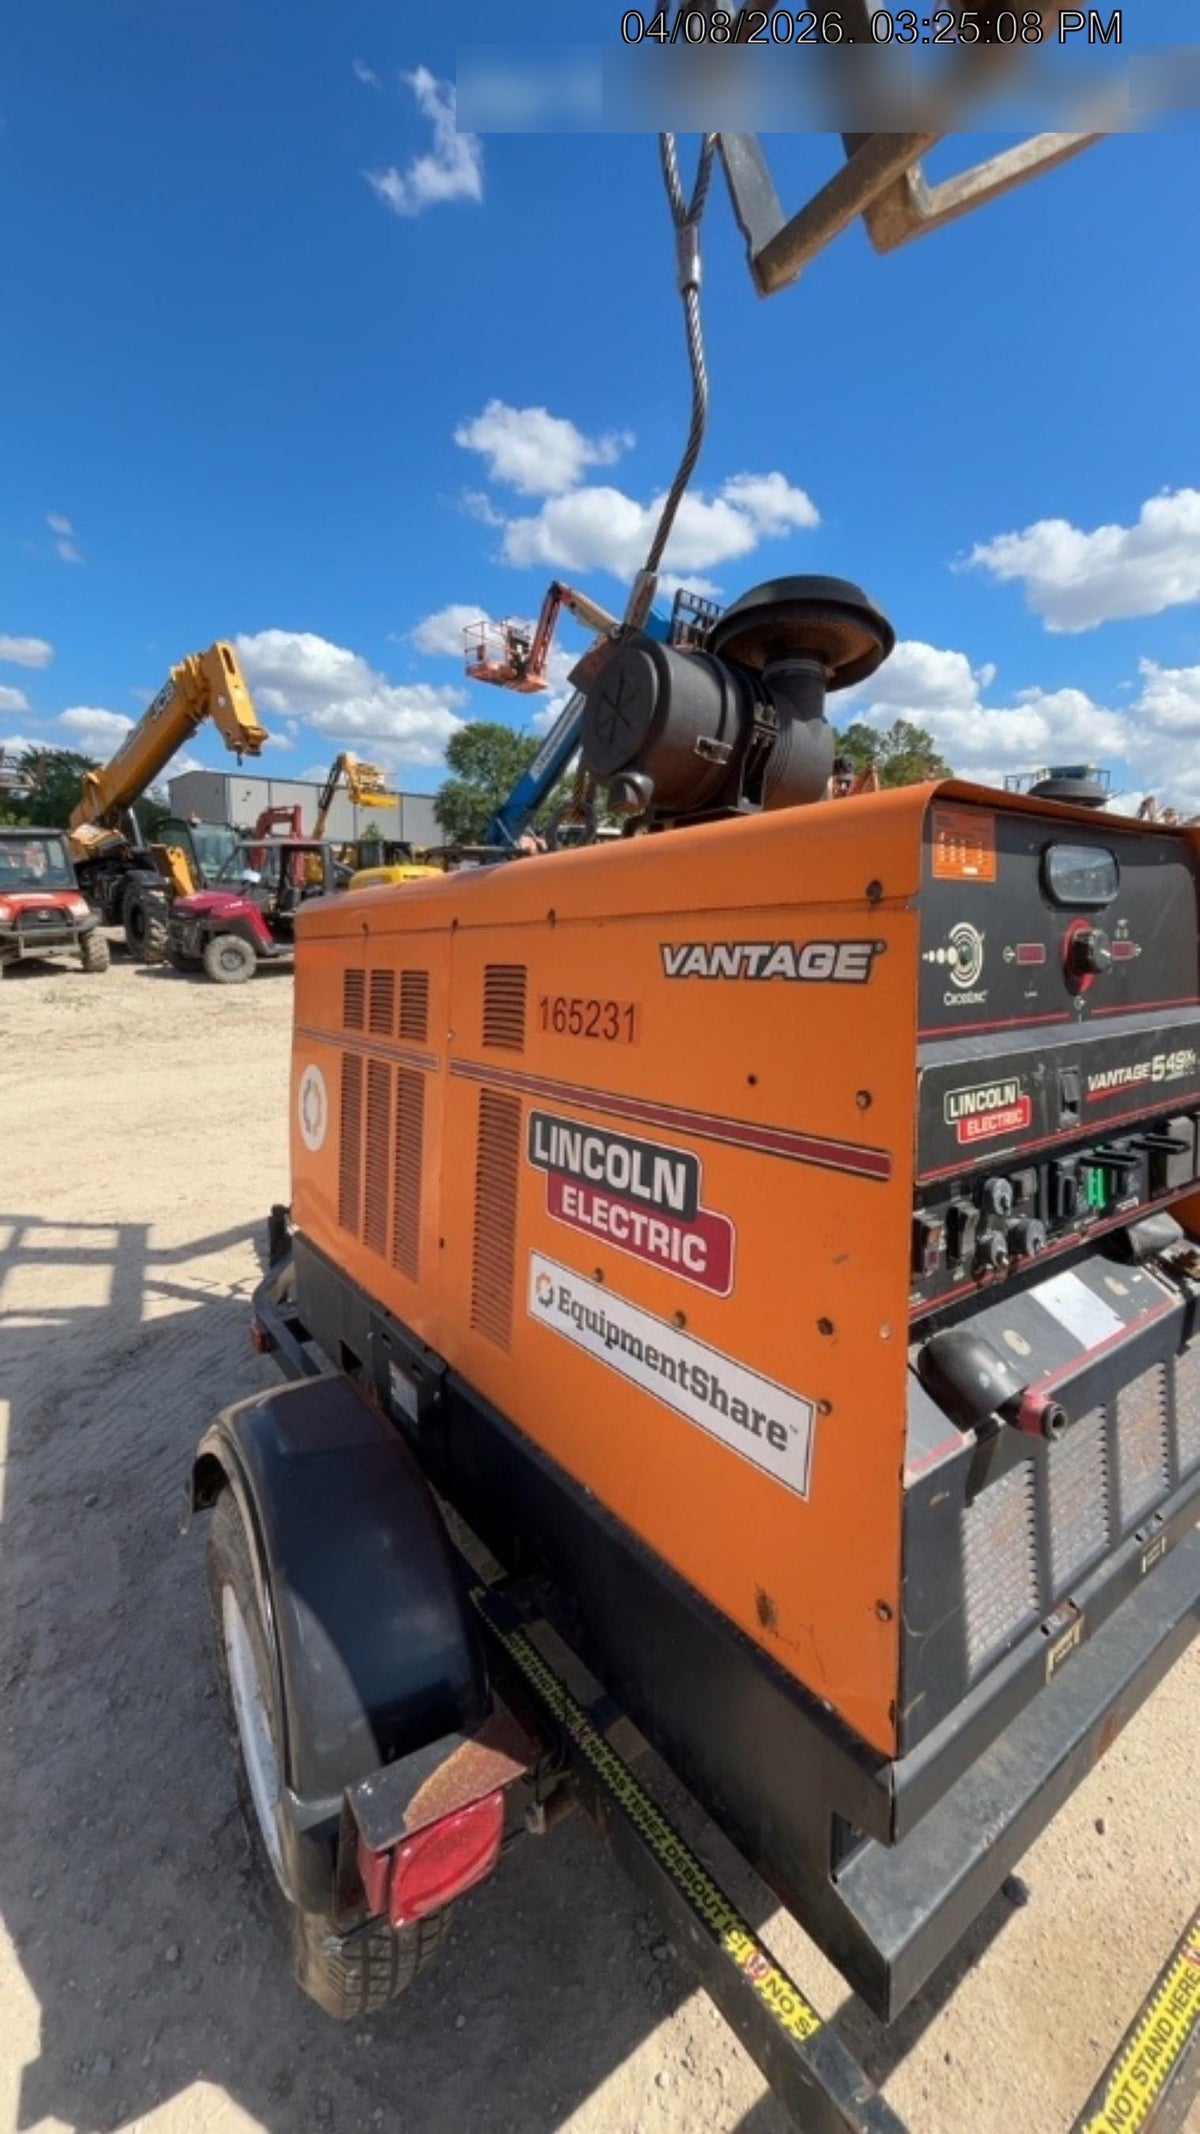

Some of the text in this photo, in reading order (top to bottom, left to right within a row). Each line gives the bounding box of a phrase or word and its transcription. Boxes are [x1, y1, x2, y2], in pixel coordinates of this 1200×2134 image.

[662, 943, 877, 981] VANTAGE
[541, 997, 636, 1043] 165231
[950, 1083, 1015, 1117] LINCOLN
[1088, 1062, 1151, 1092] VANTAGE
[967, 1106, 1024, 1136] ELECTRIC
[534, 1121, 687, 1213] LINCOLN
[561, 1185, 708, 1273] ELECTRIC
[558, 1285, 788, 1452] EquipmentShare
[665, 1844, 727, 1919] DEBOUT
[765, 1977, 796, 2014] NO
[1105, 2080, 1140, 2133] NOT
[1130, 2019, 1175, 2084] STAND
